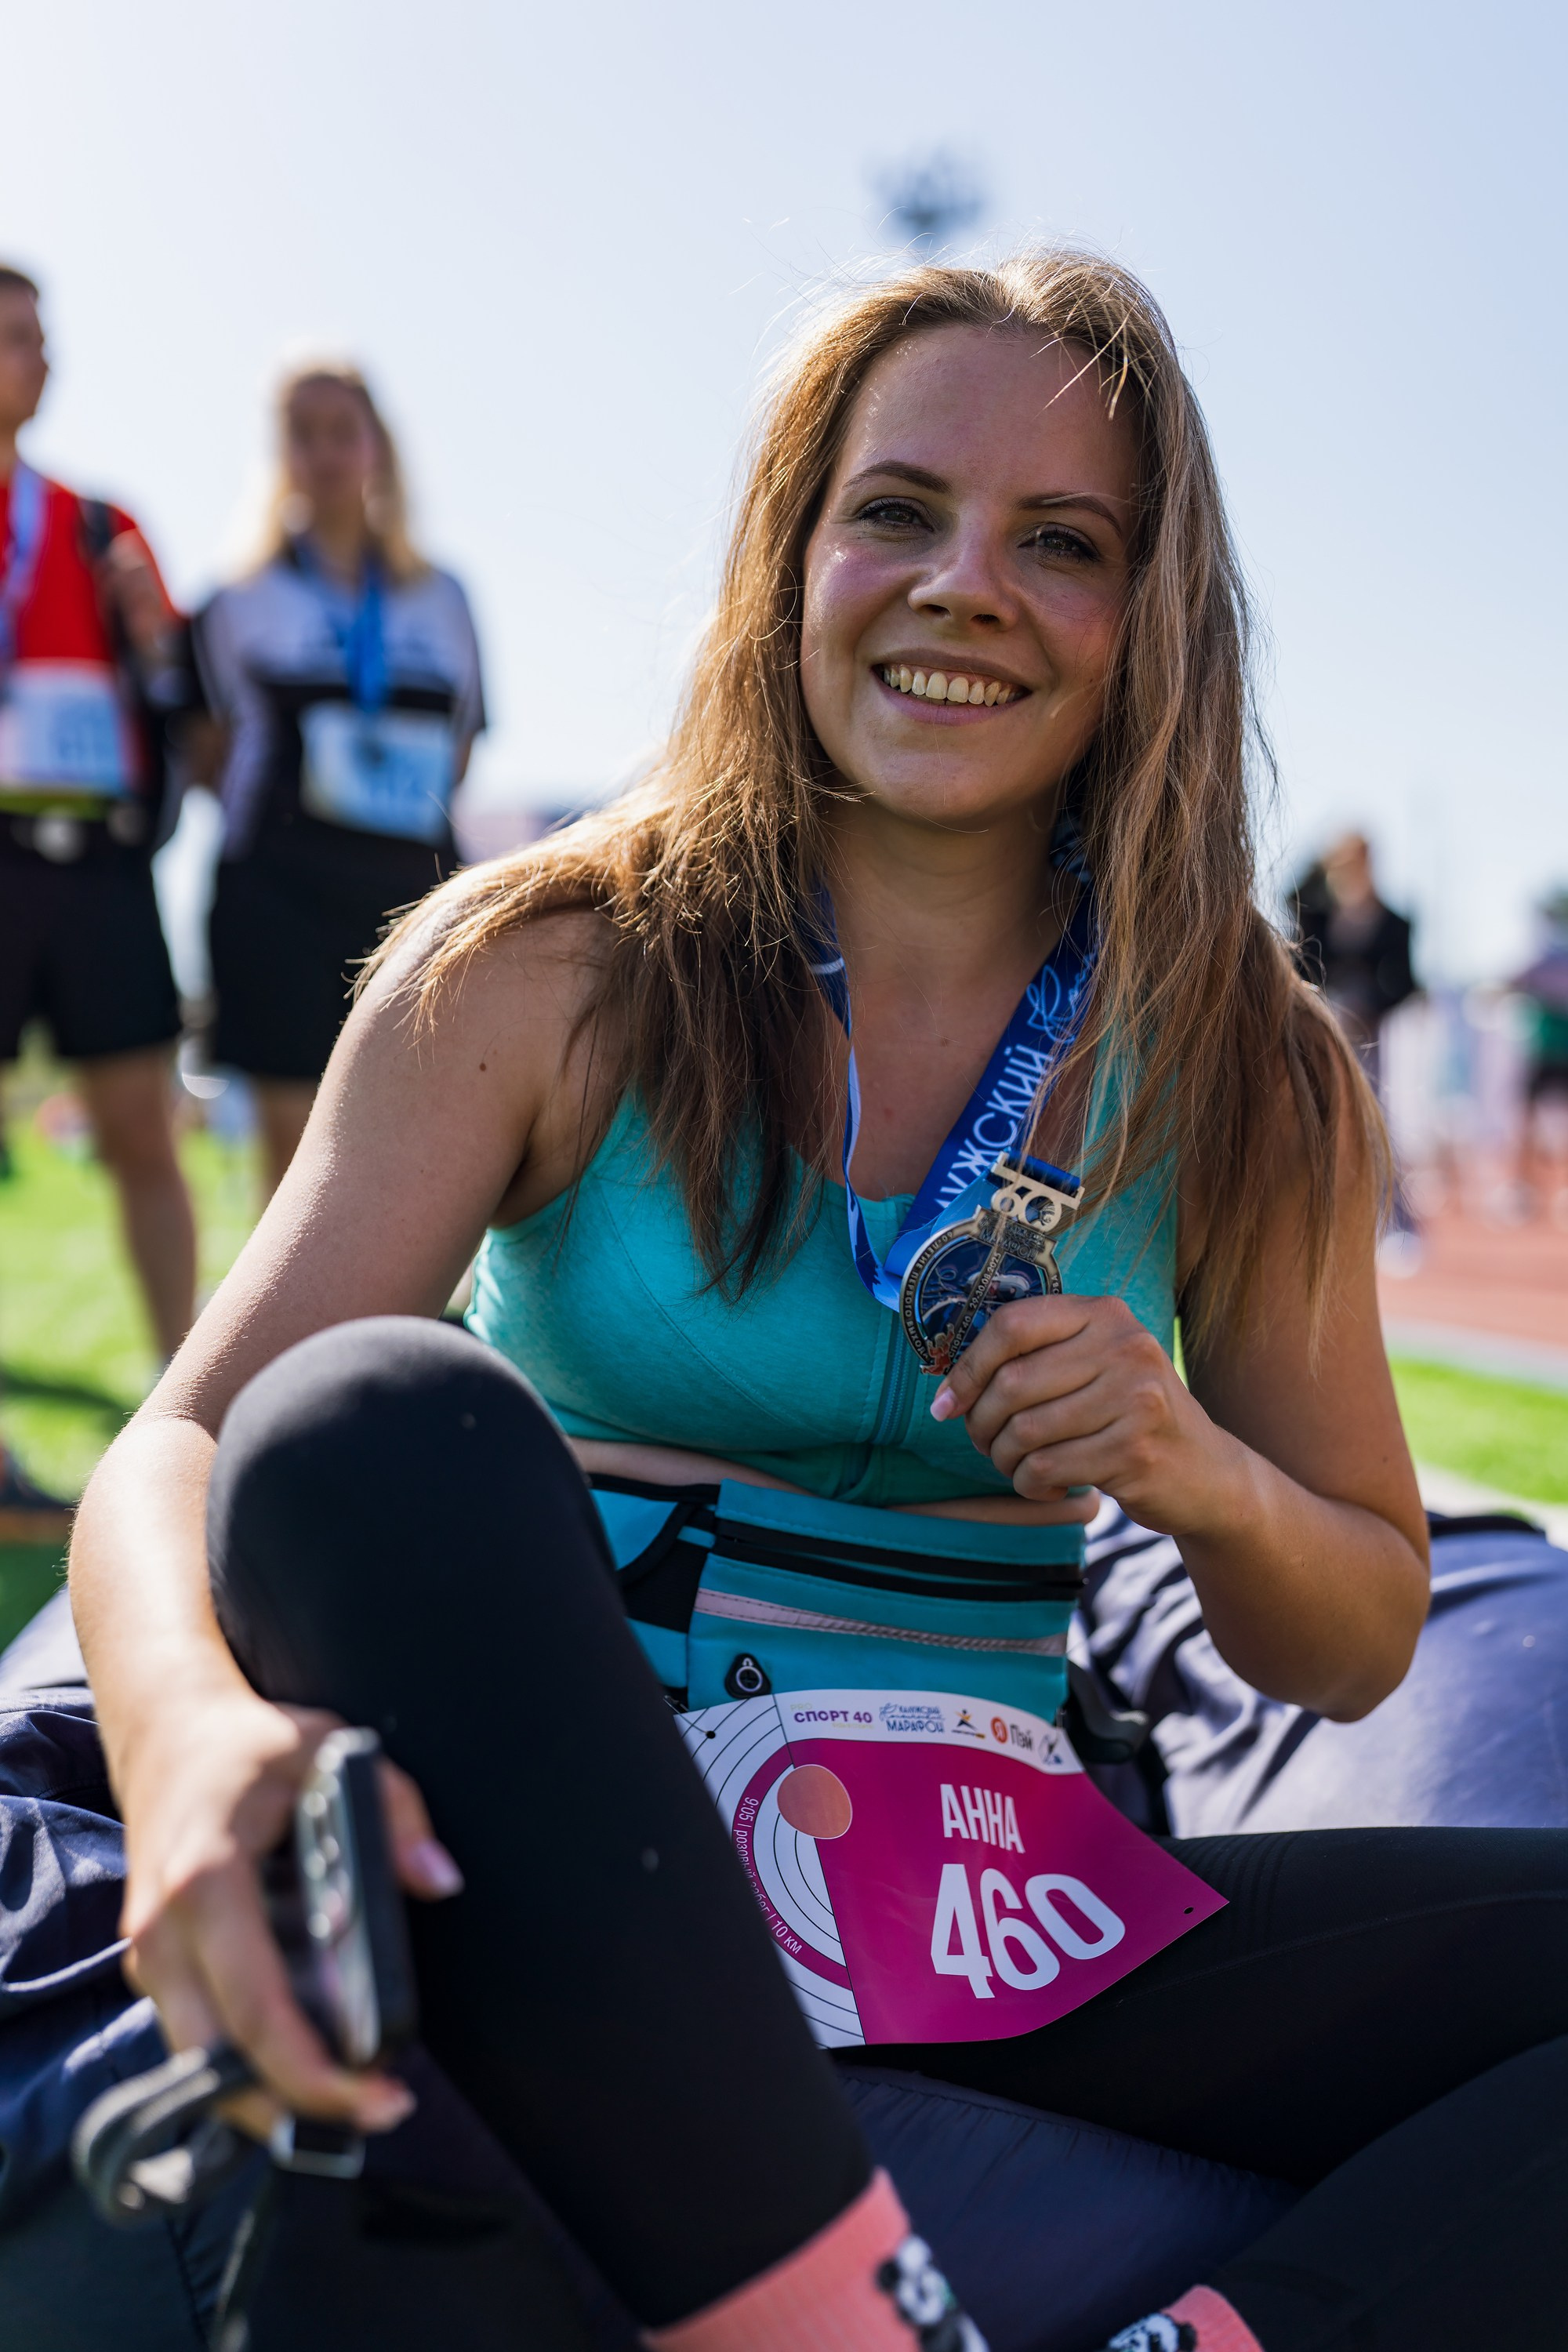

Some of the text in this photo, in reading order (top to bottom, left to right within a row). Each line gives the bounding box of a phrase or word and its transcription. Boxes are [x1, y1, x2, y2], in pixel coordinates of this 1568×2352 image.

[949, 1327, 967, 1358] СПОРТ
[964, 1316, 971, 1328] 40
[794, 1711, 849, 1723] СПОРТ
[853, 1712, 873, 1723] 40
[887, 1720, 945, 1733] МАРАФОН
[940, 1784, 1025, 1853] АННА
[739, 1797, 759, 1822] 9:05
[771, 1920, 788, 1938] 10
[931, 1864, 1125, 1999] 460
